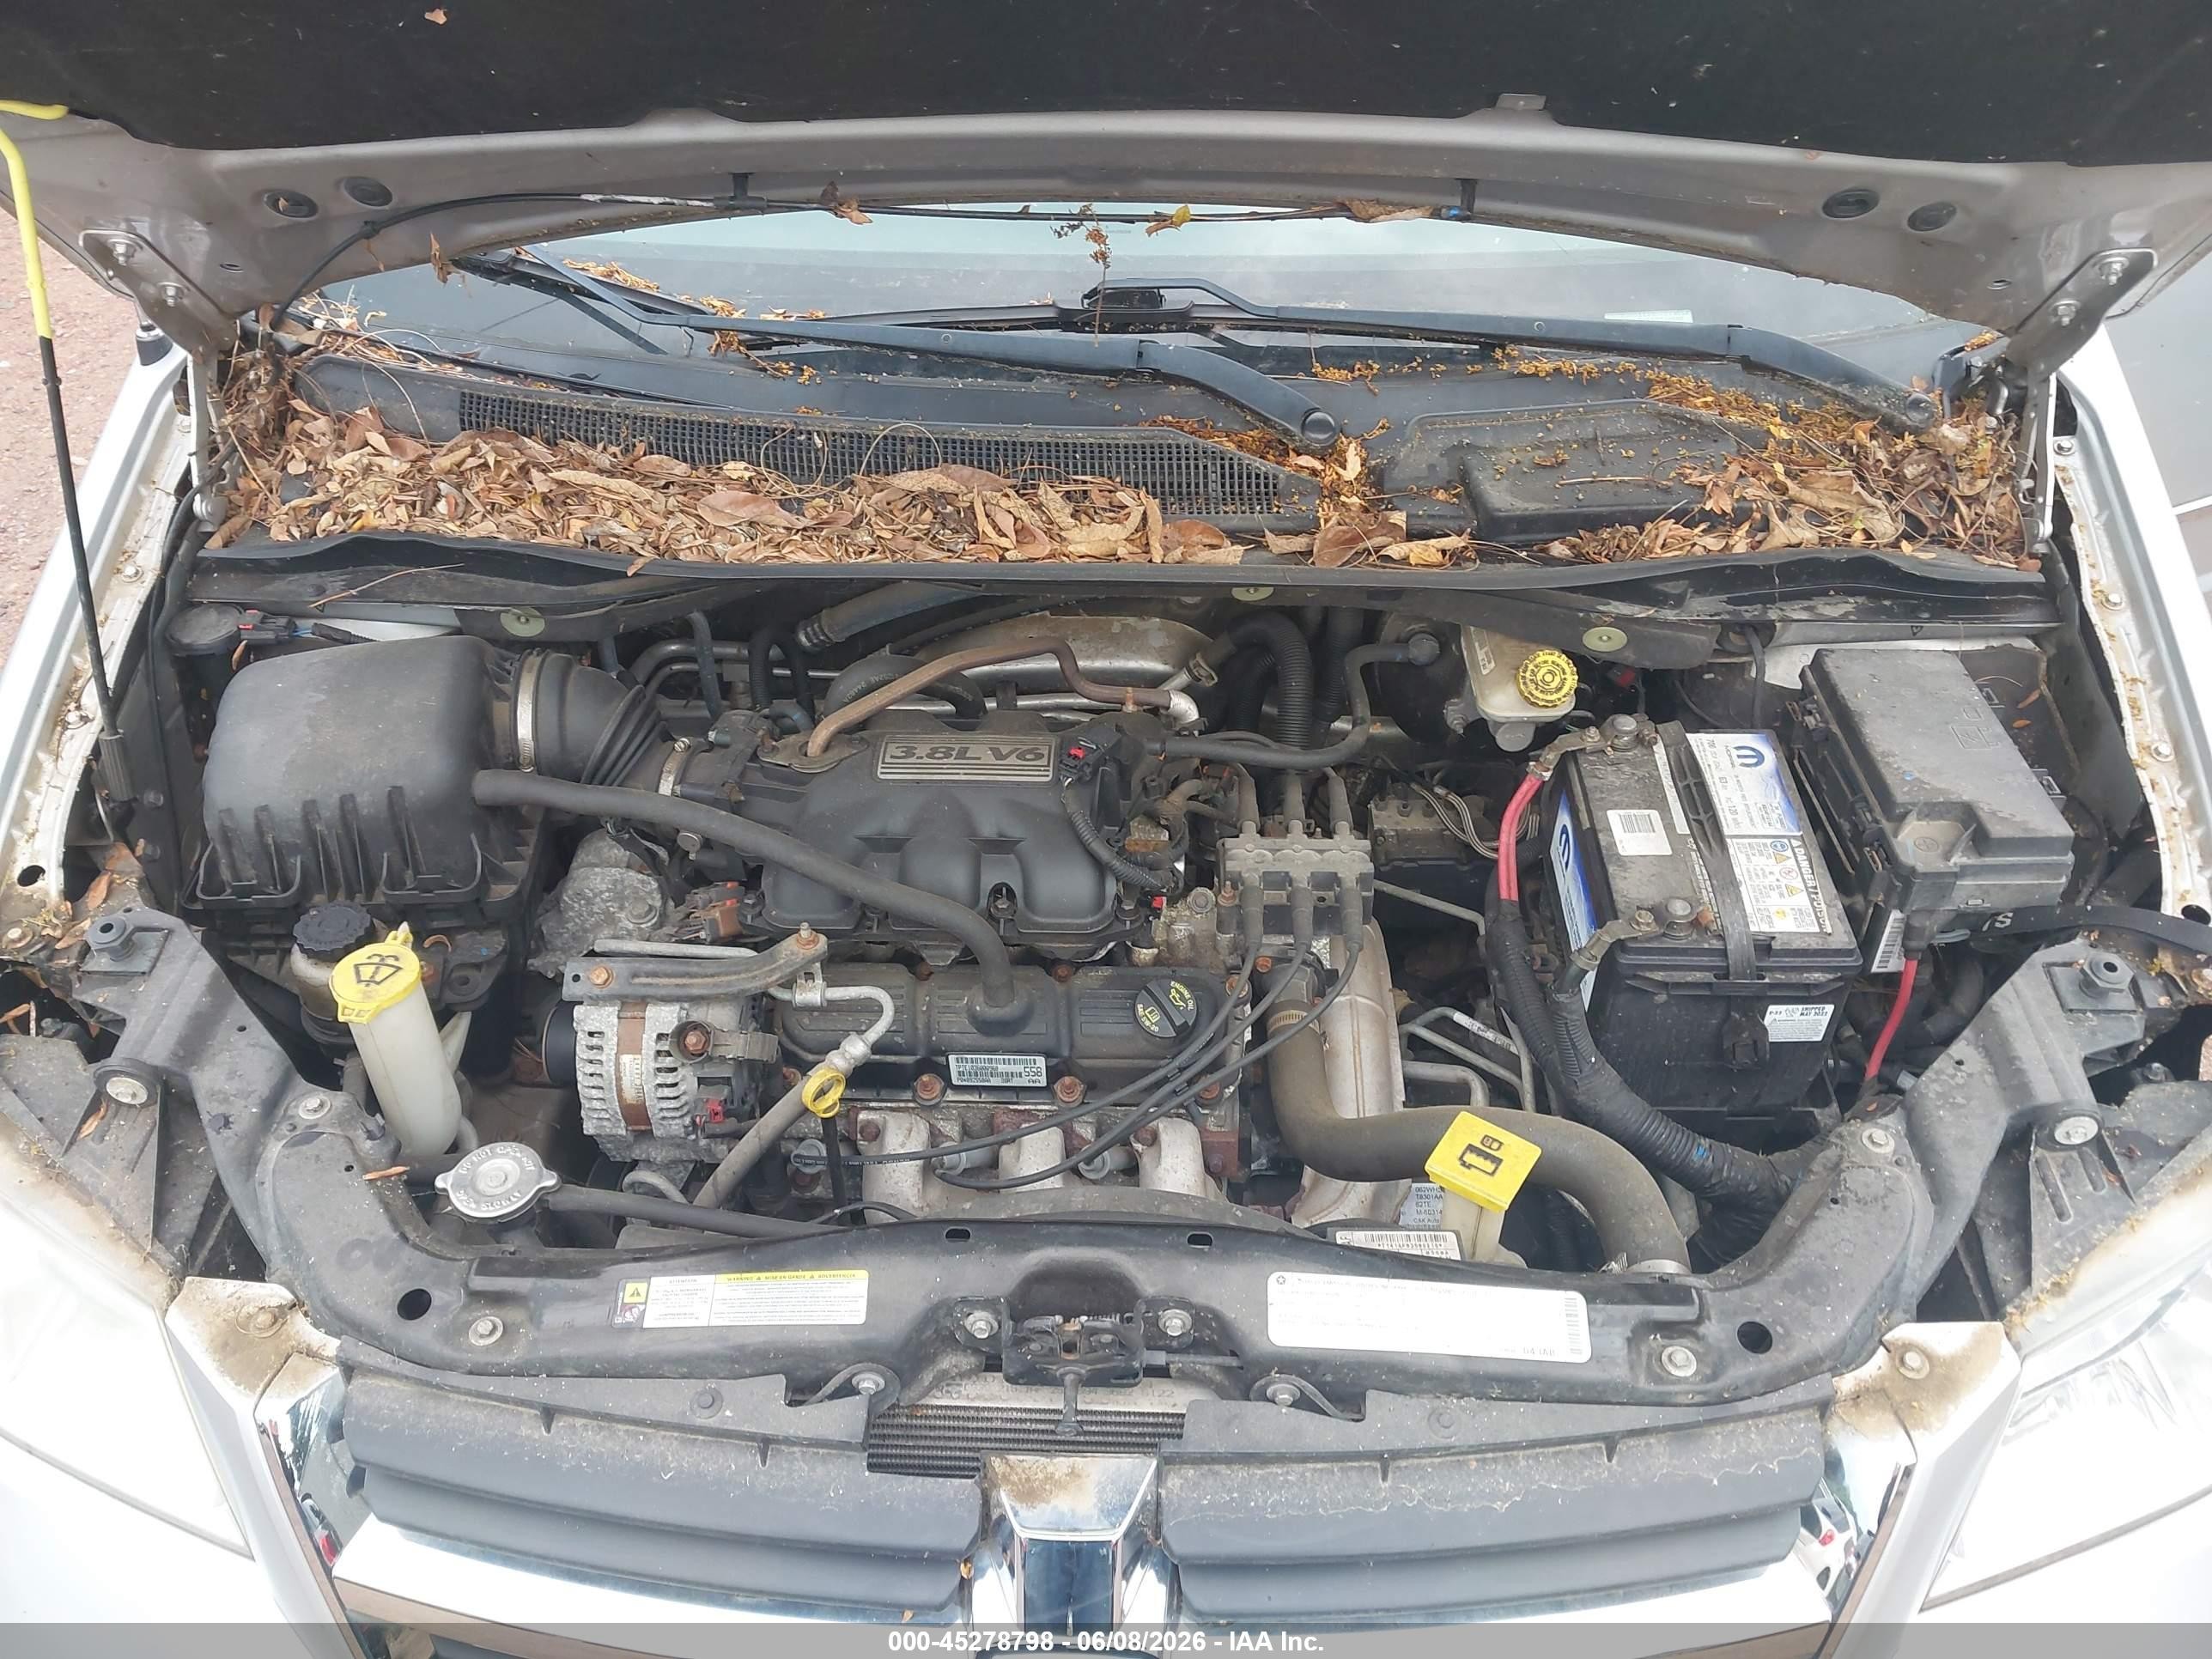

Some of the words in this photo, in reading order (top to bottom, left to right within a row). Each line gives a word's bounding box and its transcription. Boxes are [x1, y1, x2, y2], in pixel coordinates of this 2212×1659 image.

[890, 744, 981, 761] 3.8L
[983, 745, 1045, 763] V6
[1793, 848, 1817, 888] DANGER
[1170, 980, 1191, 1000] ENGINE
[1024, 1066, 1043, 1078] 558
[458, 1161, 472, 1175] DO
[471, 1147, 494, 1163] NOT
[496, 1145, 522, 1158] OPEN
[455, 1188, 477, 1210] OPEN
[481, 1190, 521, 1210] SLOWLY
